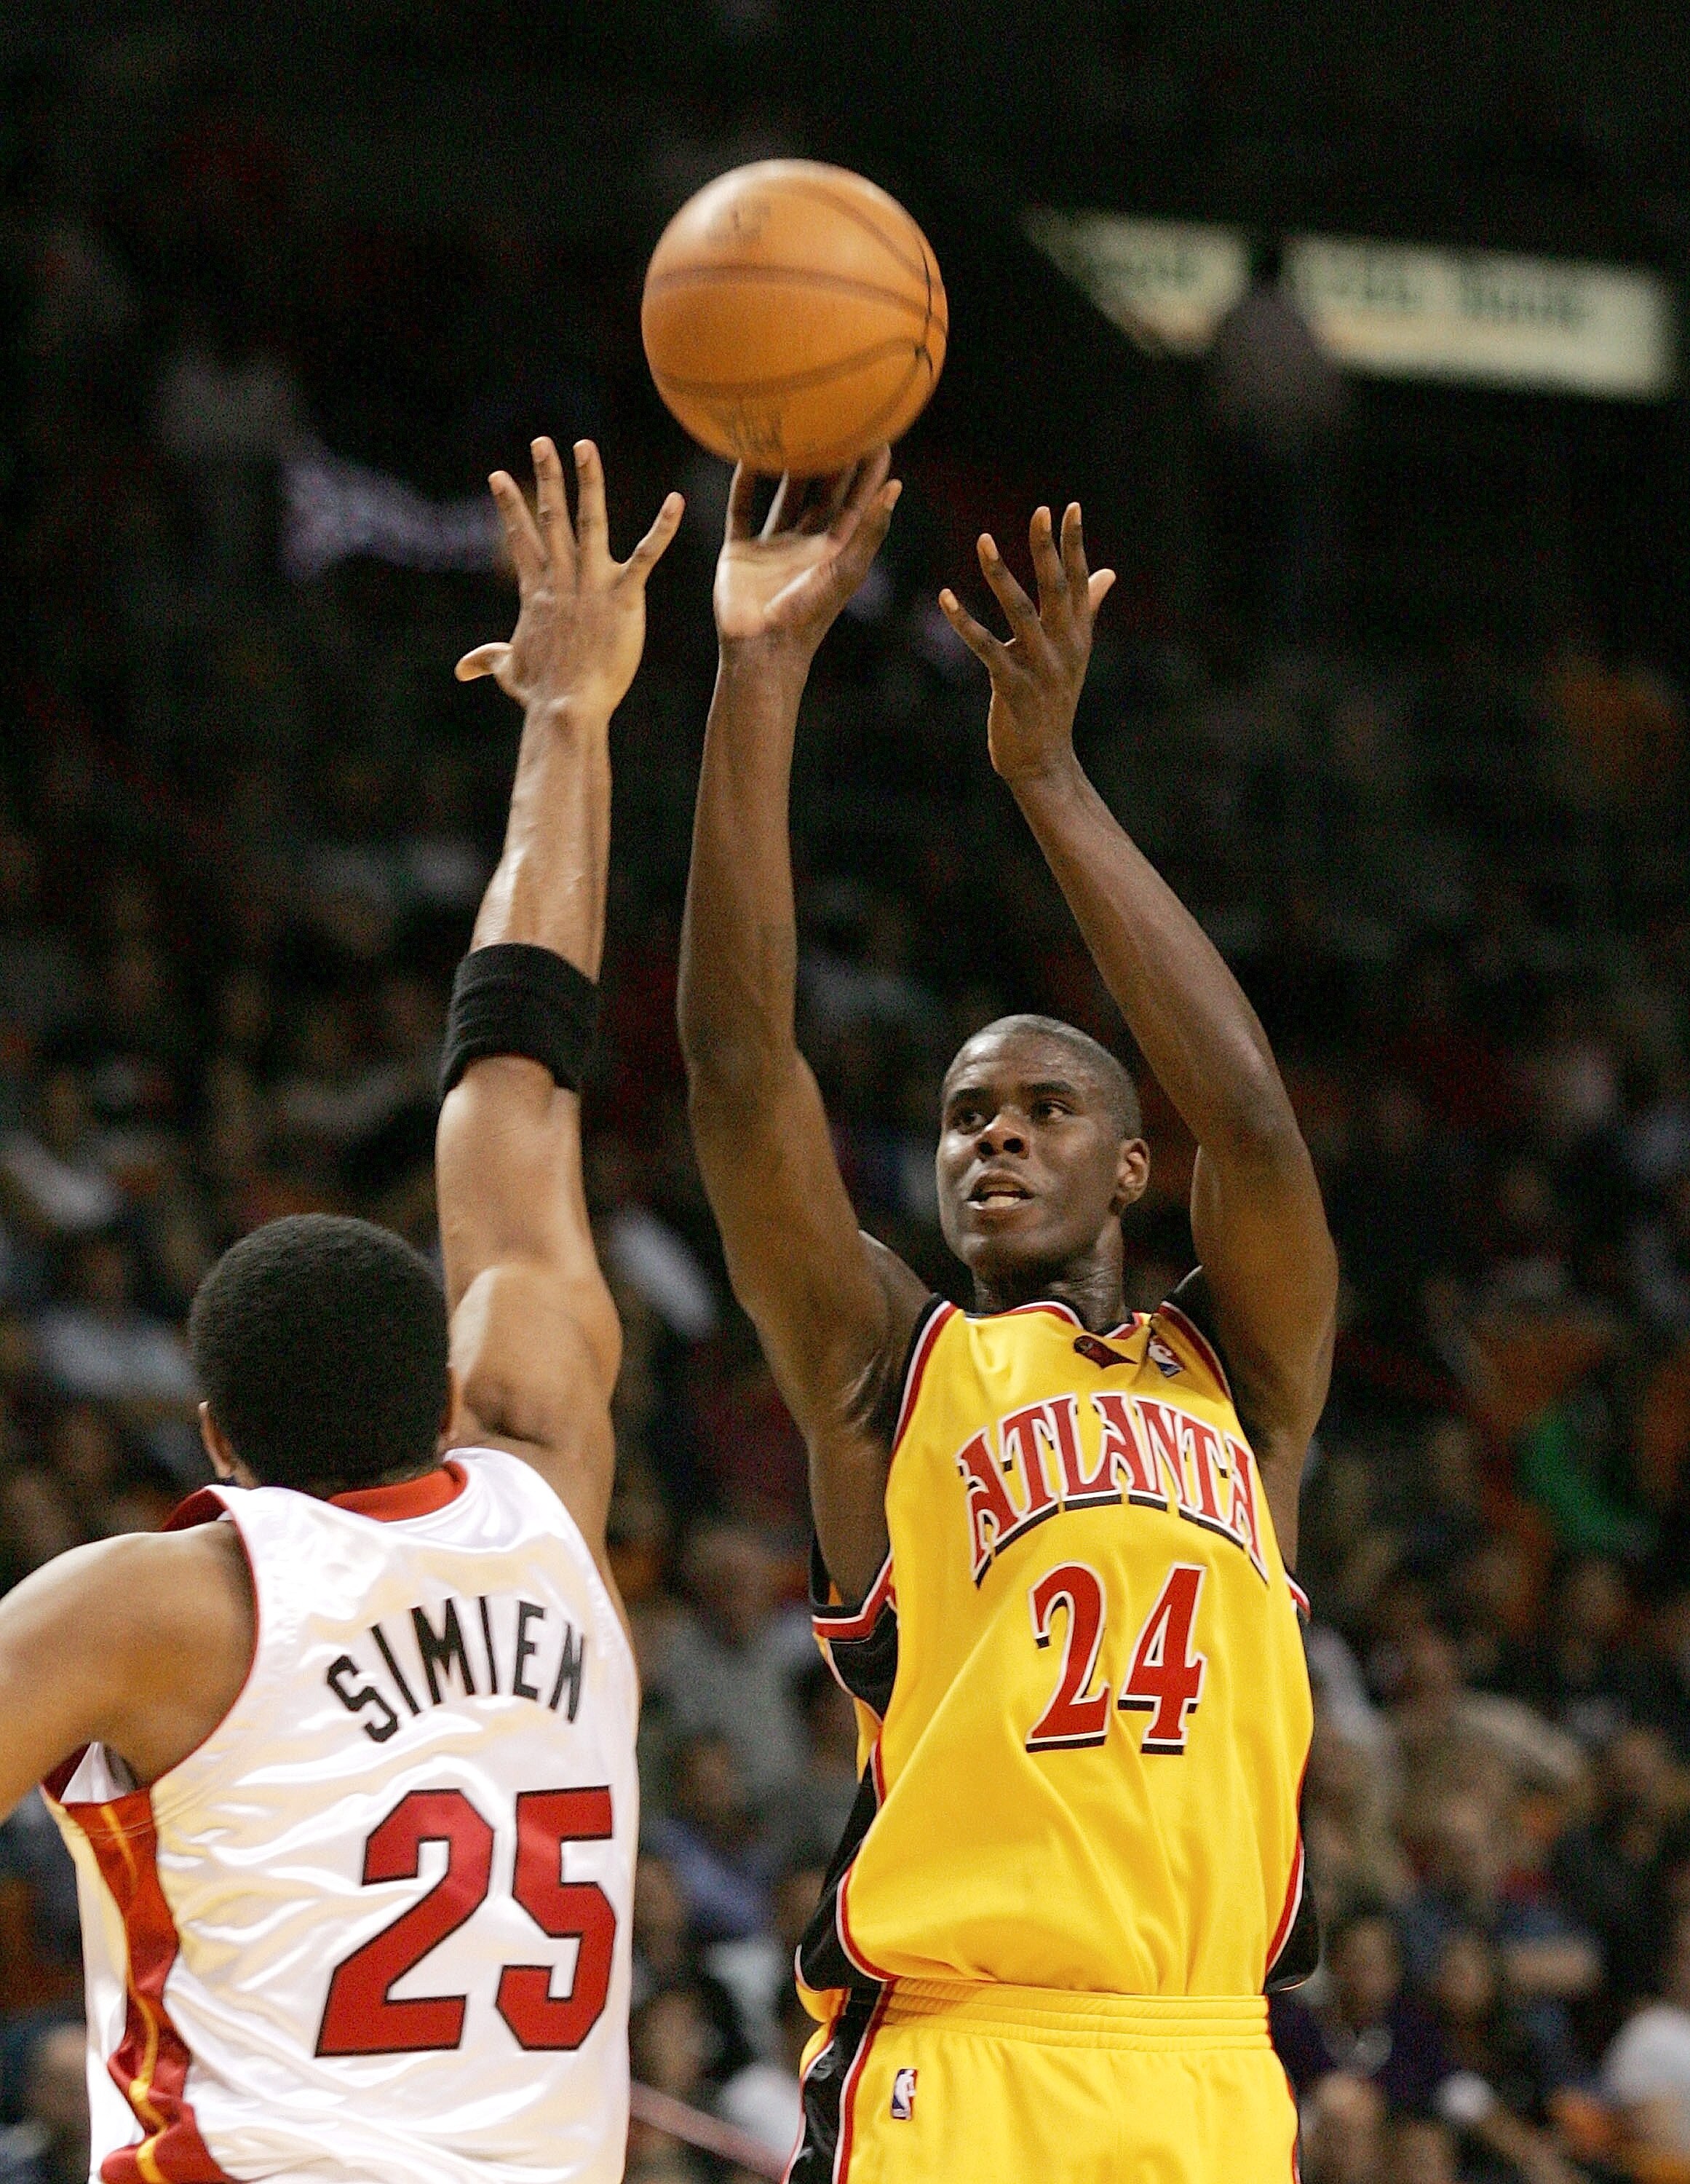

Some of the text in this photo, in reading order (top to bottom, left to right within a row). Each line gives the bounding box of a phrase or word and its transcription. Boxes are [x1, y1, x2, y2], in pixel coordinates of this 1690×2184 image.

[954, 1391, 1270, 1589] ATLANTA
[326, 1595, 586, 1743] SIMIEN
[1025, 1560, 1208, 1756] 24
[314, 1785, 617, 2058] 25
